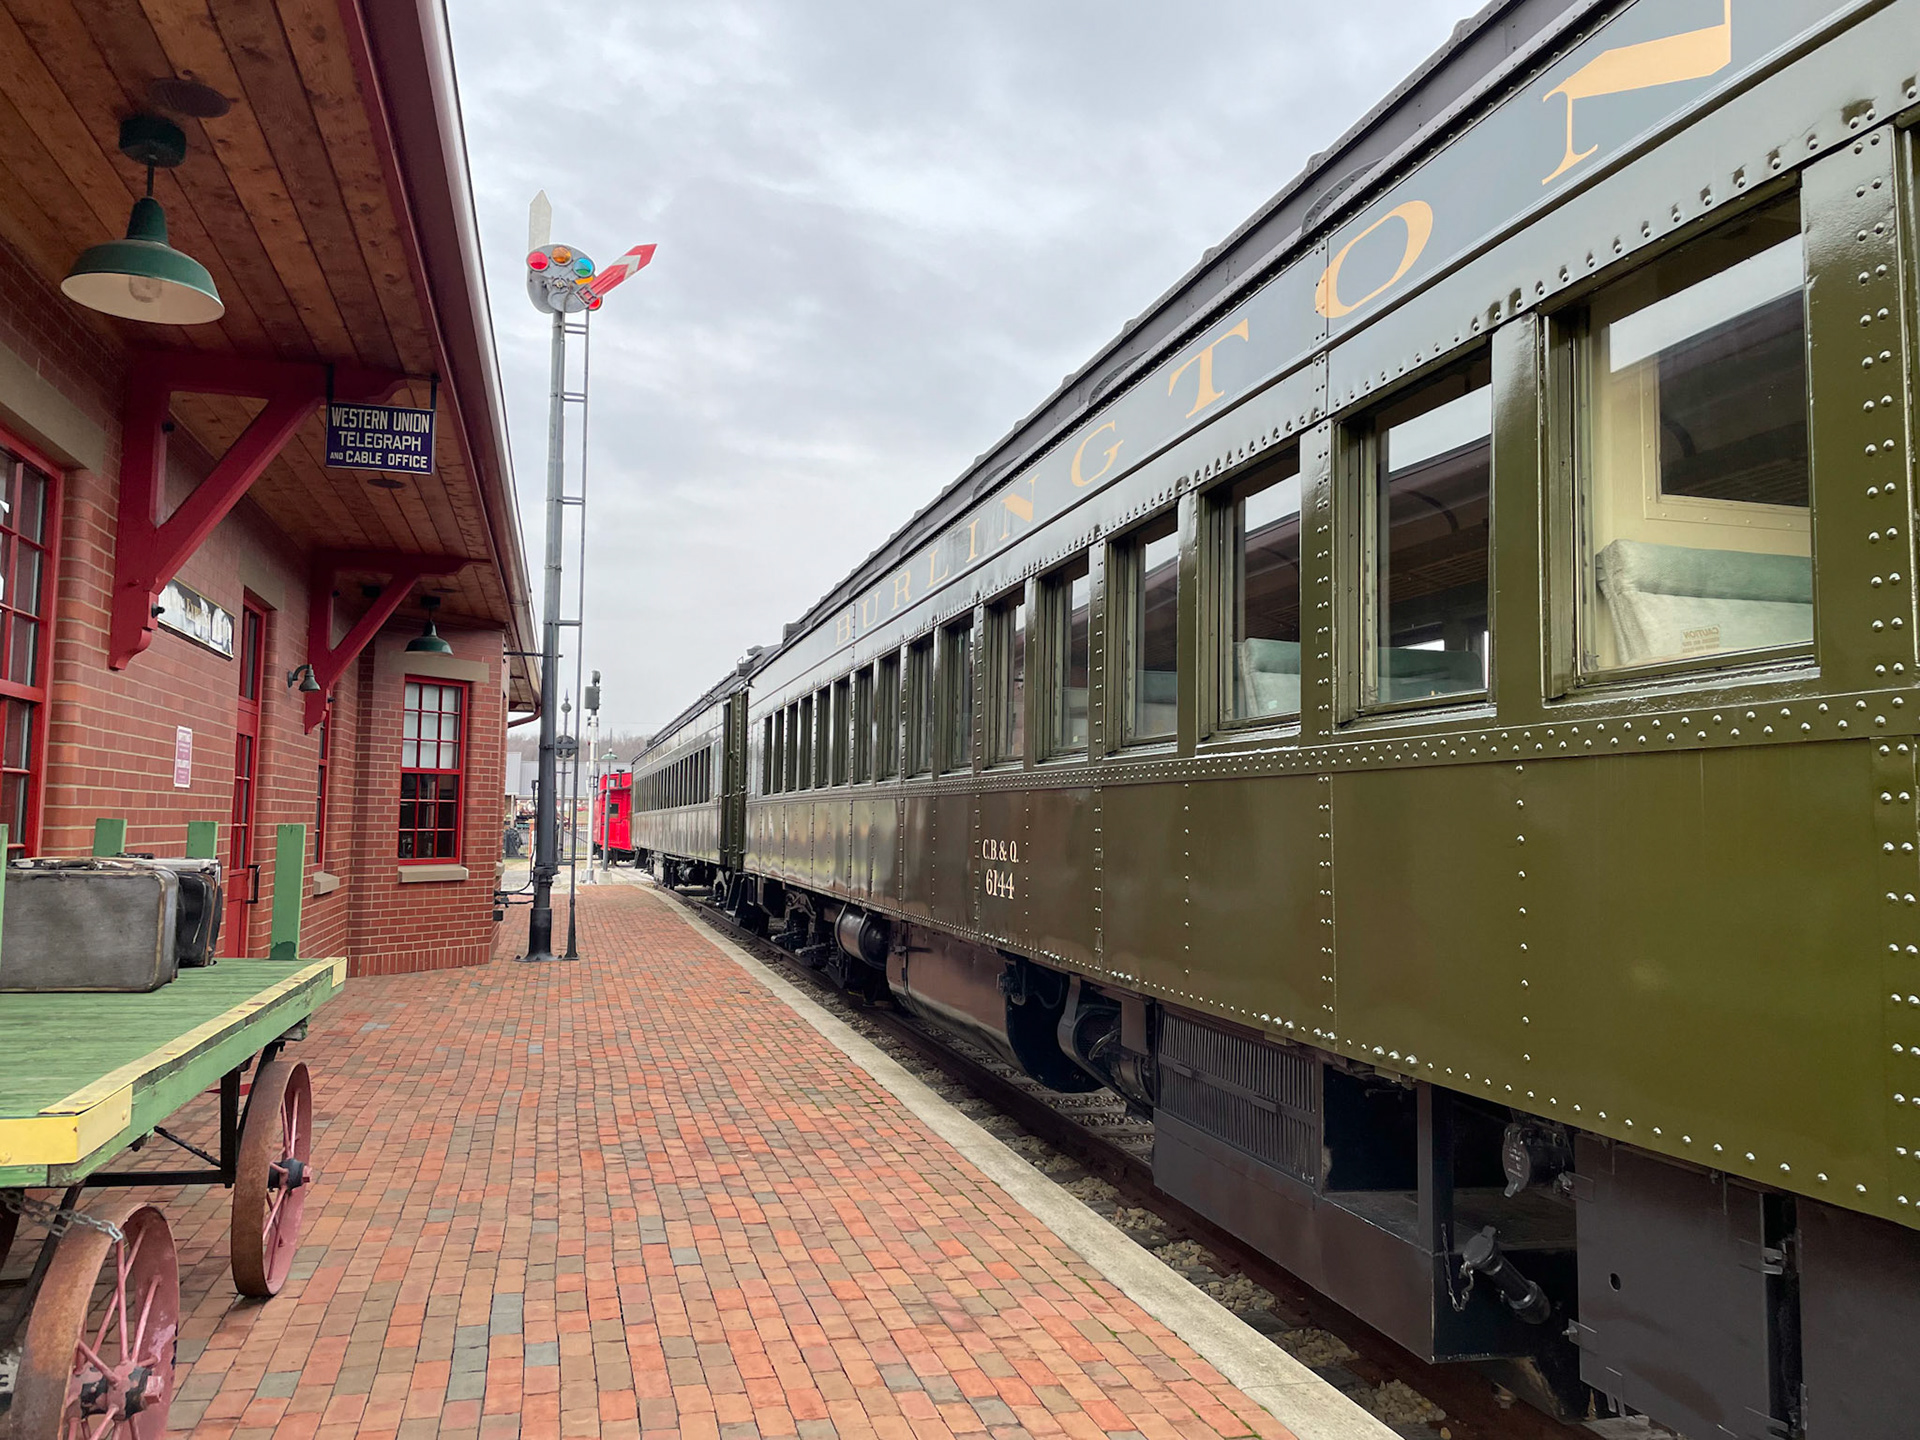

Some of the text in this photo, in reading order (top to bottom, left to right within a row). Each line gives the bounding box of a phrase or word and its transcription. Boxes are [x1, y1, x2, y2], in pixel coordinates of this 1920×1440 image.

[835, 0, 1732, 647] BURLINGTON
[331, 406, 430, 434] WESTERN UNION
[338, 430, 422, 452] TELEGRAPH
[330, 449, 428, 469] AND CABLE OFFICE
[985, 868, 1015, 900] 6144
